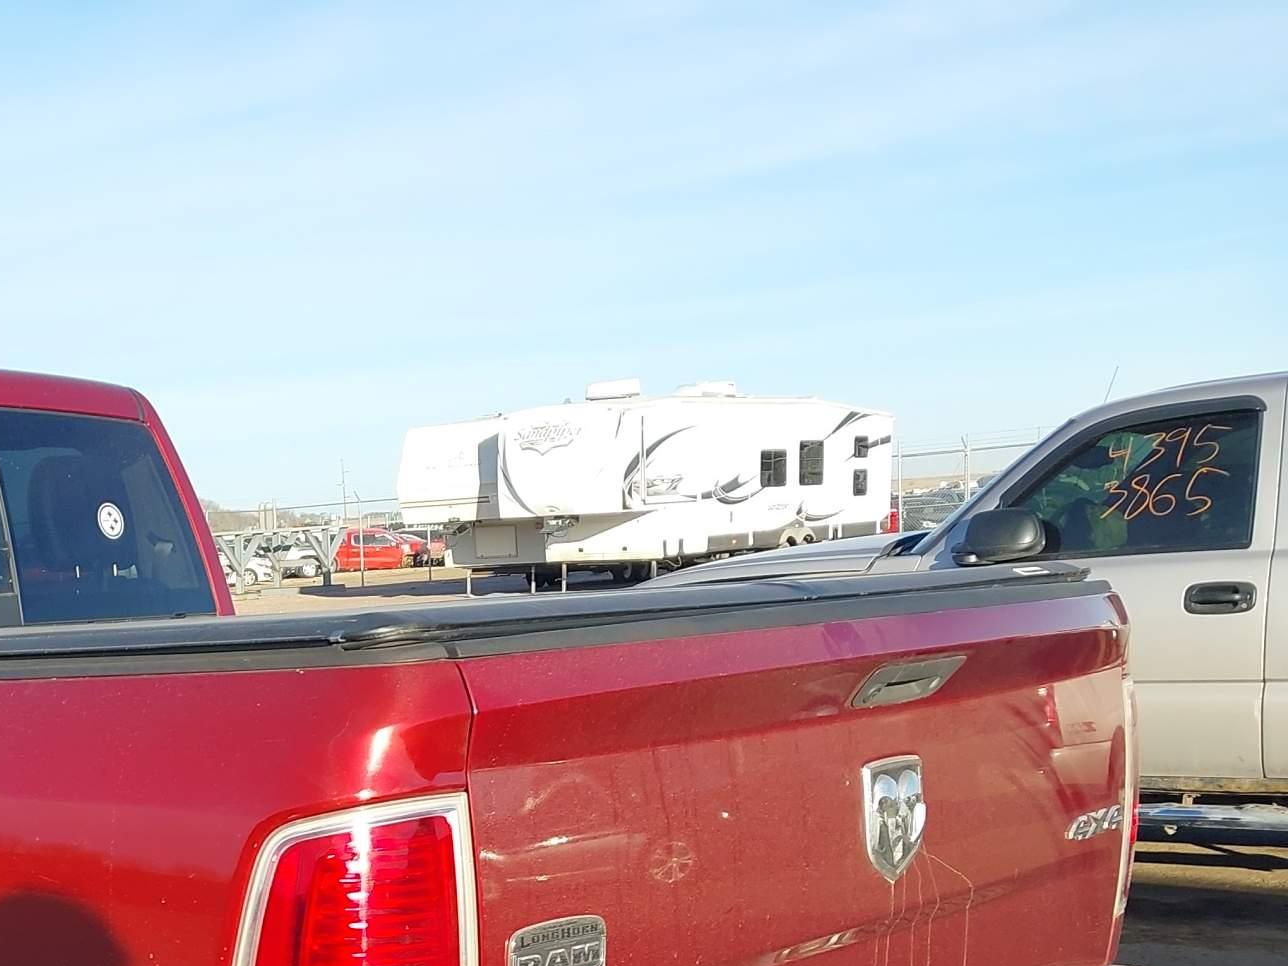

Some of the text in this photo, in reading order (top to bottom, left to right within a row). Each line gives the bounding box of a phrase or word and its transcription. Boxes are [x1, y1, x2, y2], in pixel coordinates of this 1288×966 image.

[1109, 424, 1232, 479] 4395
[1100, 466, 1231, 520] 3865
[520, 923, 598, 949] LONGHORN
